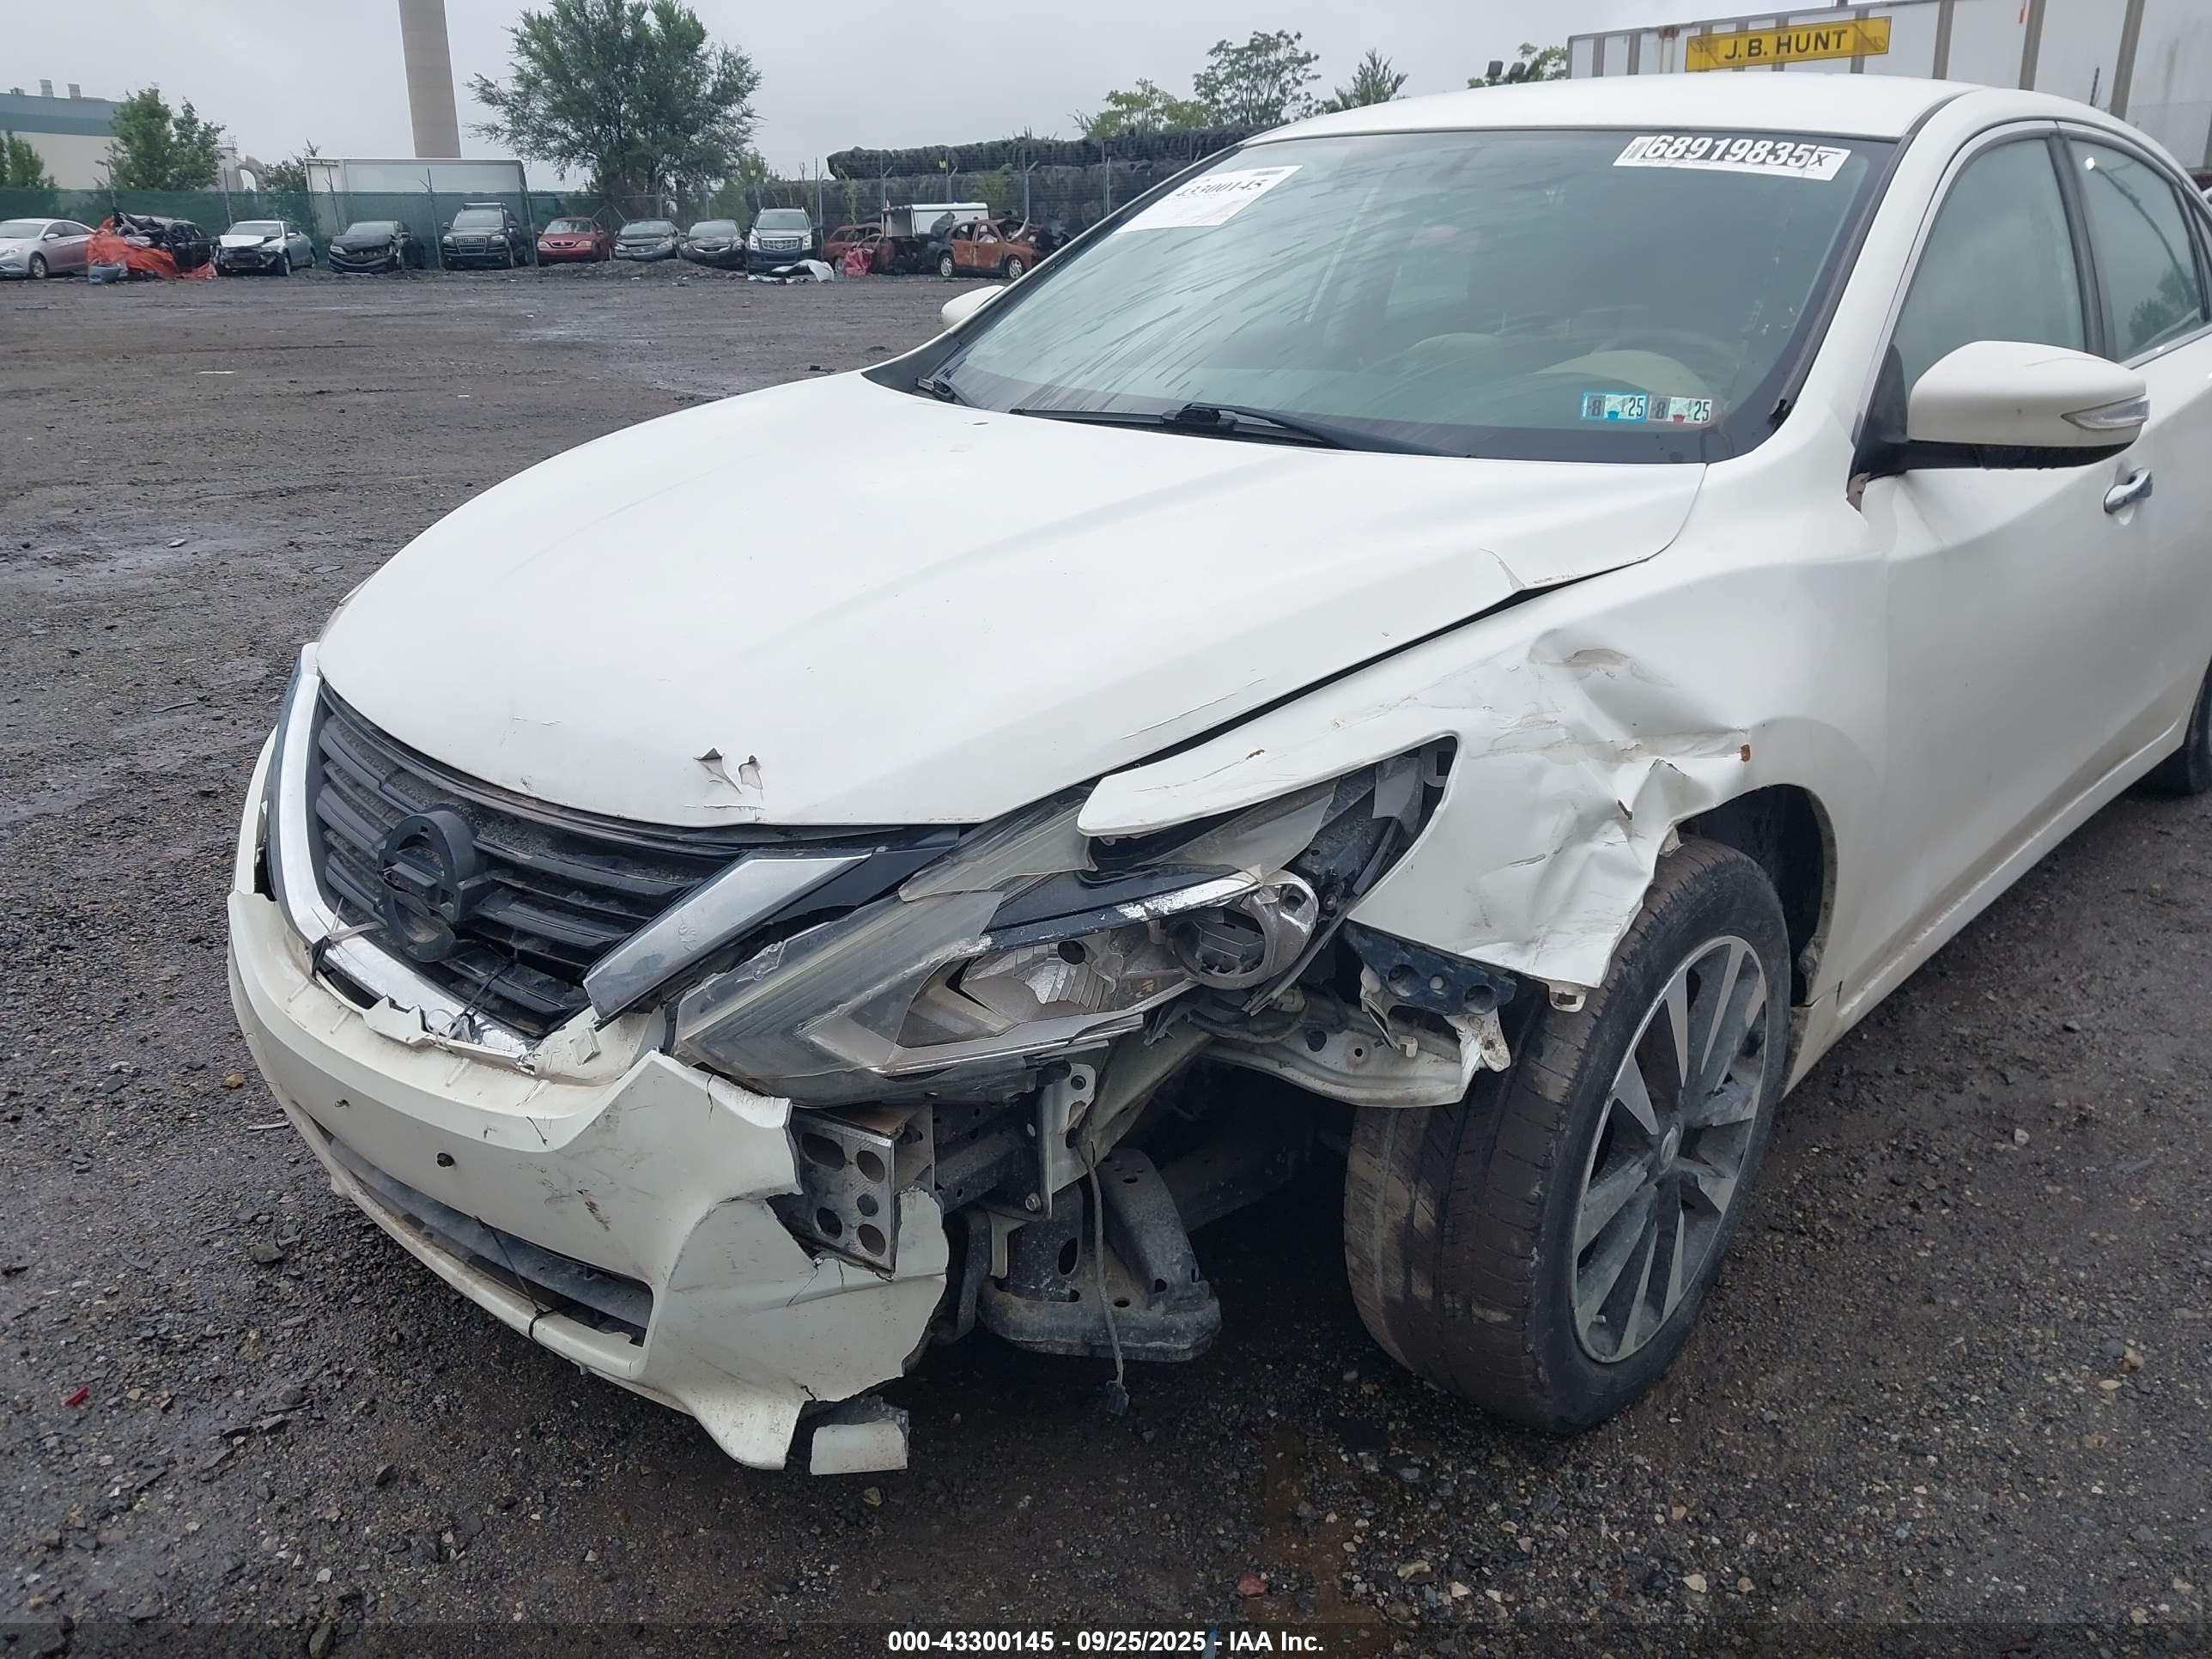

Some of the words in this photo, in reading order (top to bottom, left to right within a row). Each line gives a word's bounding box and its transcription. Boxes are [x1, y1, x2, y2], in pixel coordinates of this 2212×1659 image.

[1776, 29, 1848, 55] HUNT
[1643, 135, 1817, 168] 68919835
[1627, 397, 1644, 417] 25
[1693, 400, 1711, 422] 25
